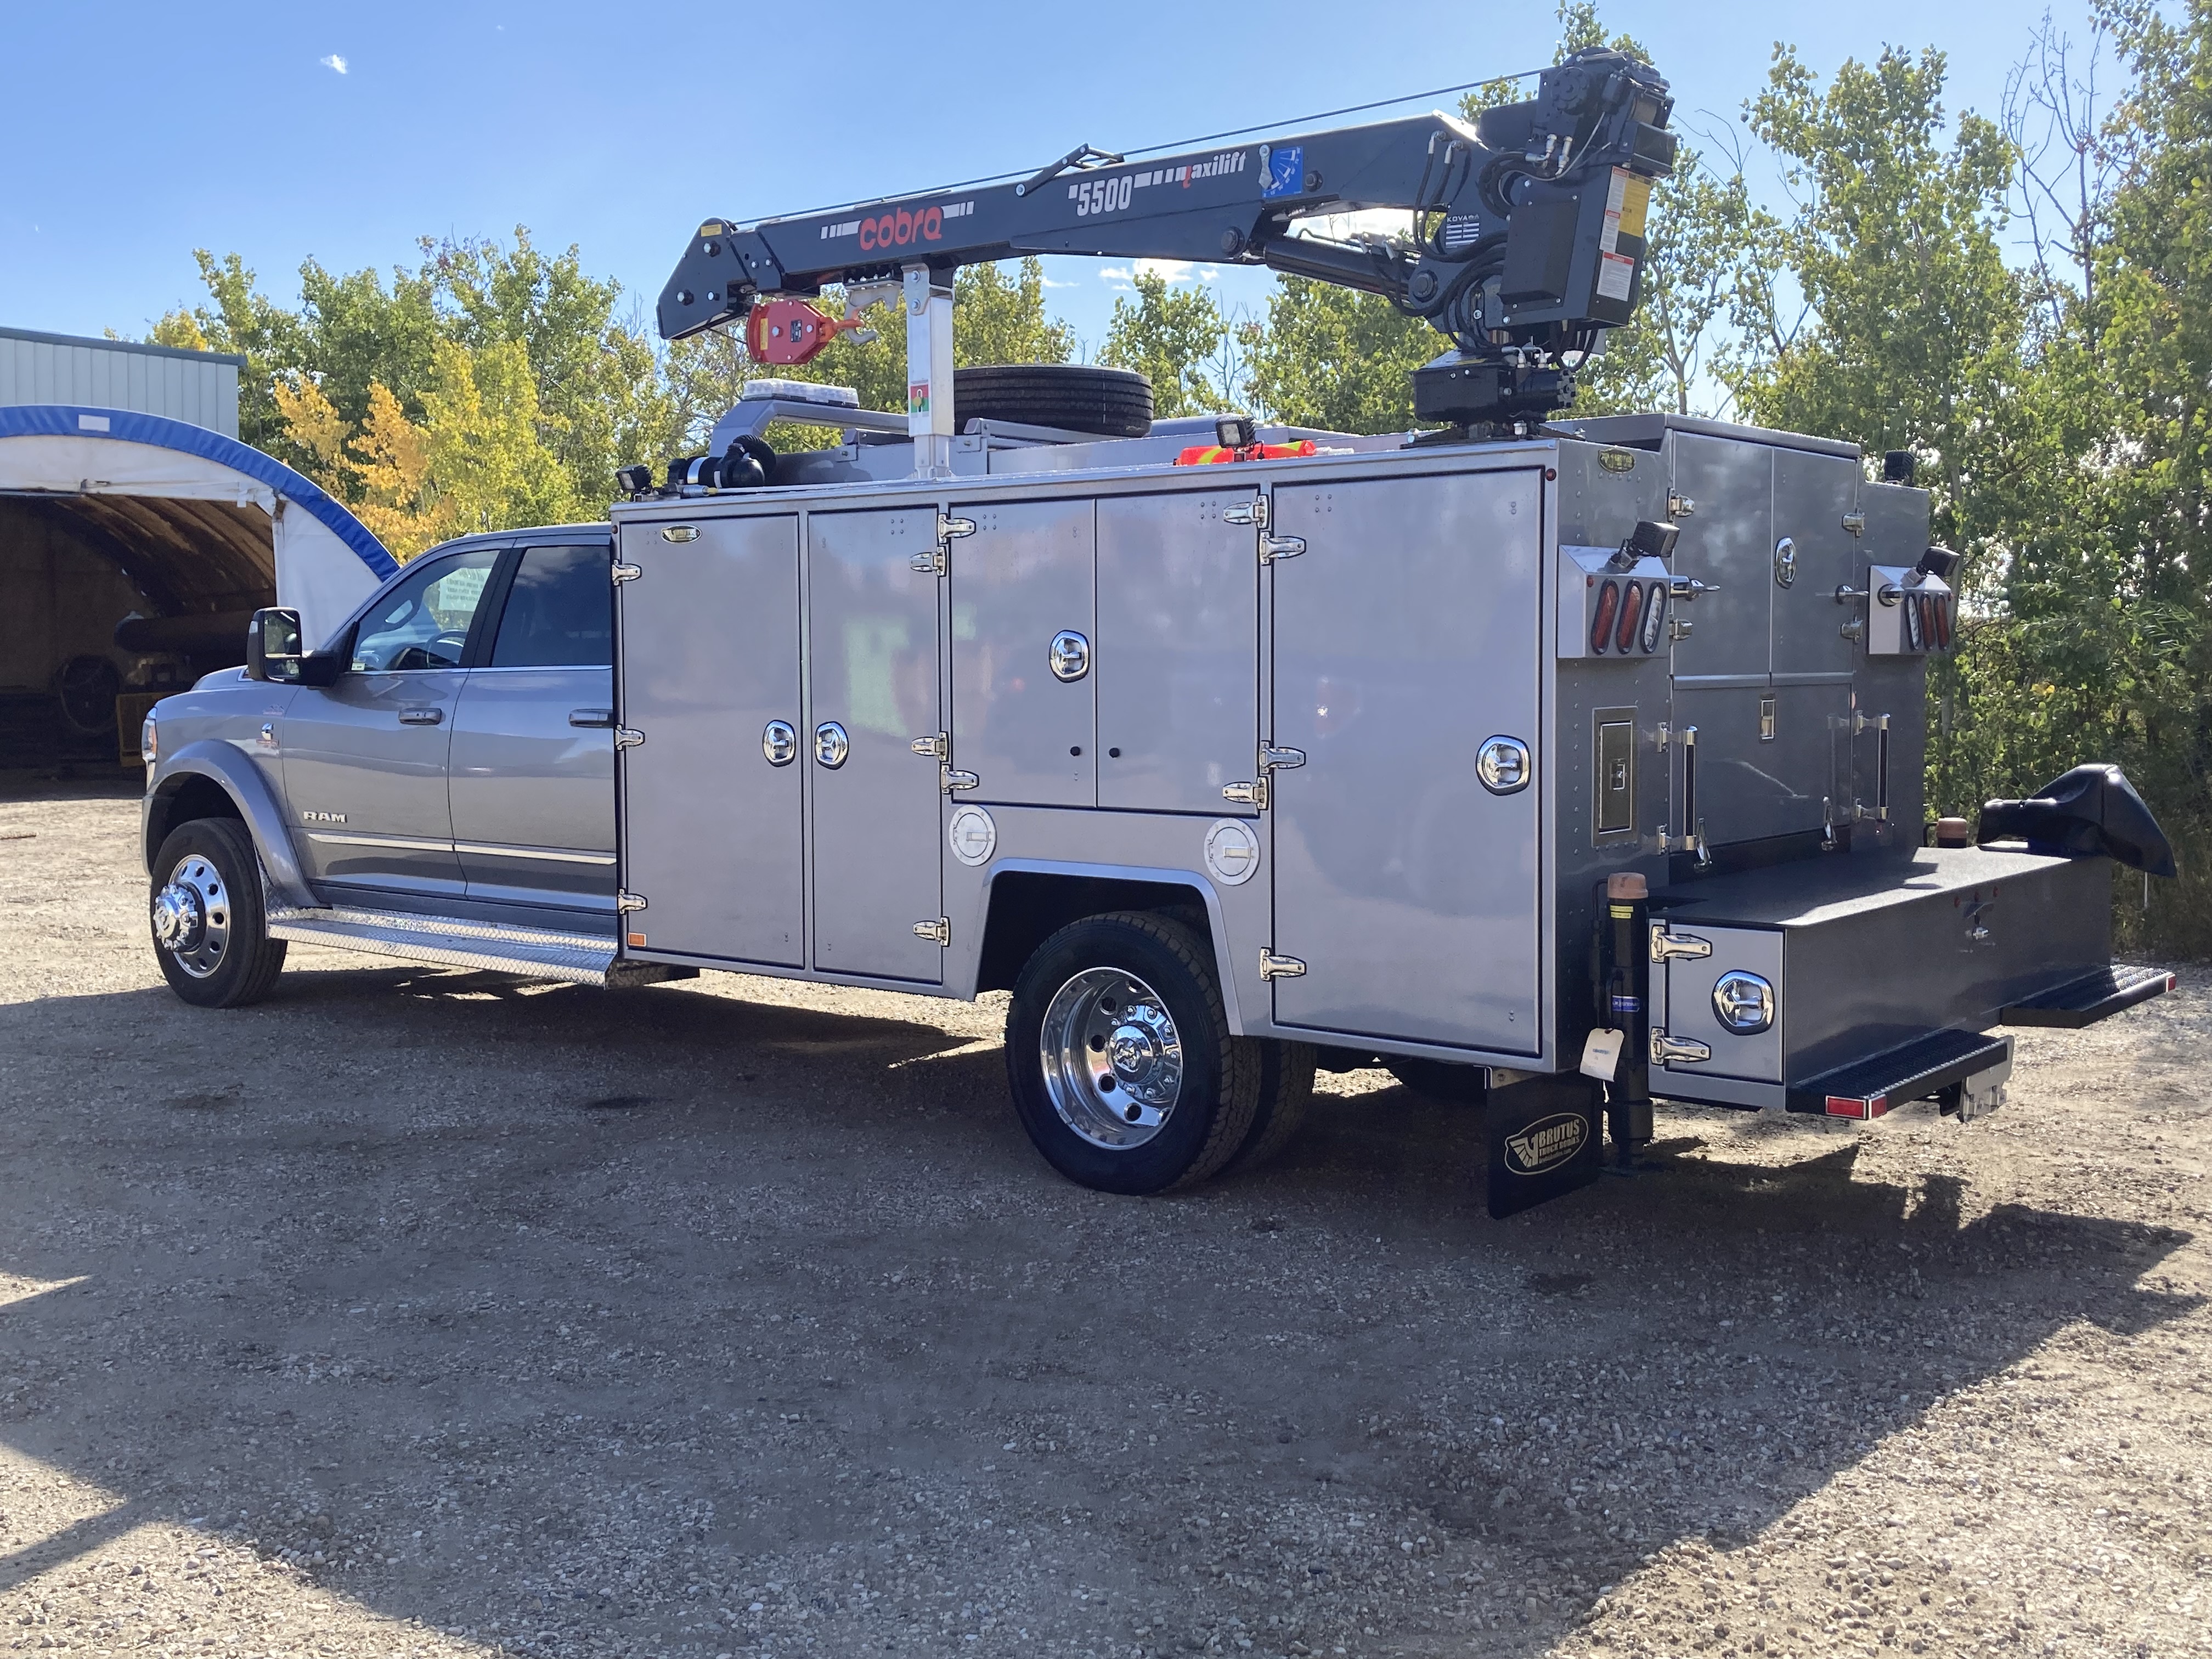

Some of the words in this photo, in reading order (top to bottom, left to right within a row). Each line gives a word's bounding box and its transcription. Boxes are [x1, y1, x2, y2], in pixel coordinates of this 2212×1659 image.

[1076, 176, 1133, 216] 5500
[860, 206, 943, 251] cobra
[303, 811, 348, 823] RAM
[1539, 1119, 1580, 1148] BRUTUS
[1539, 1142, 1559, 1157] TRUCK
